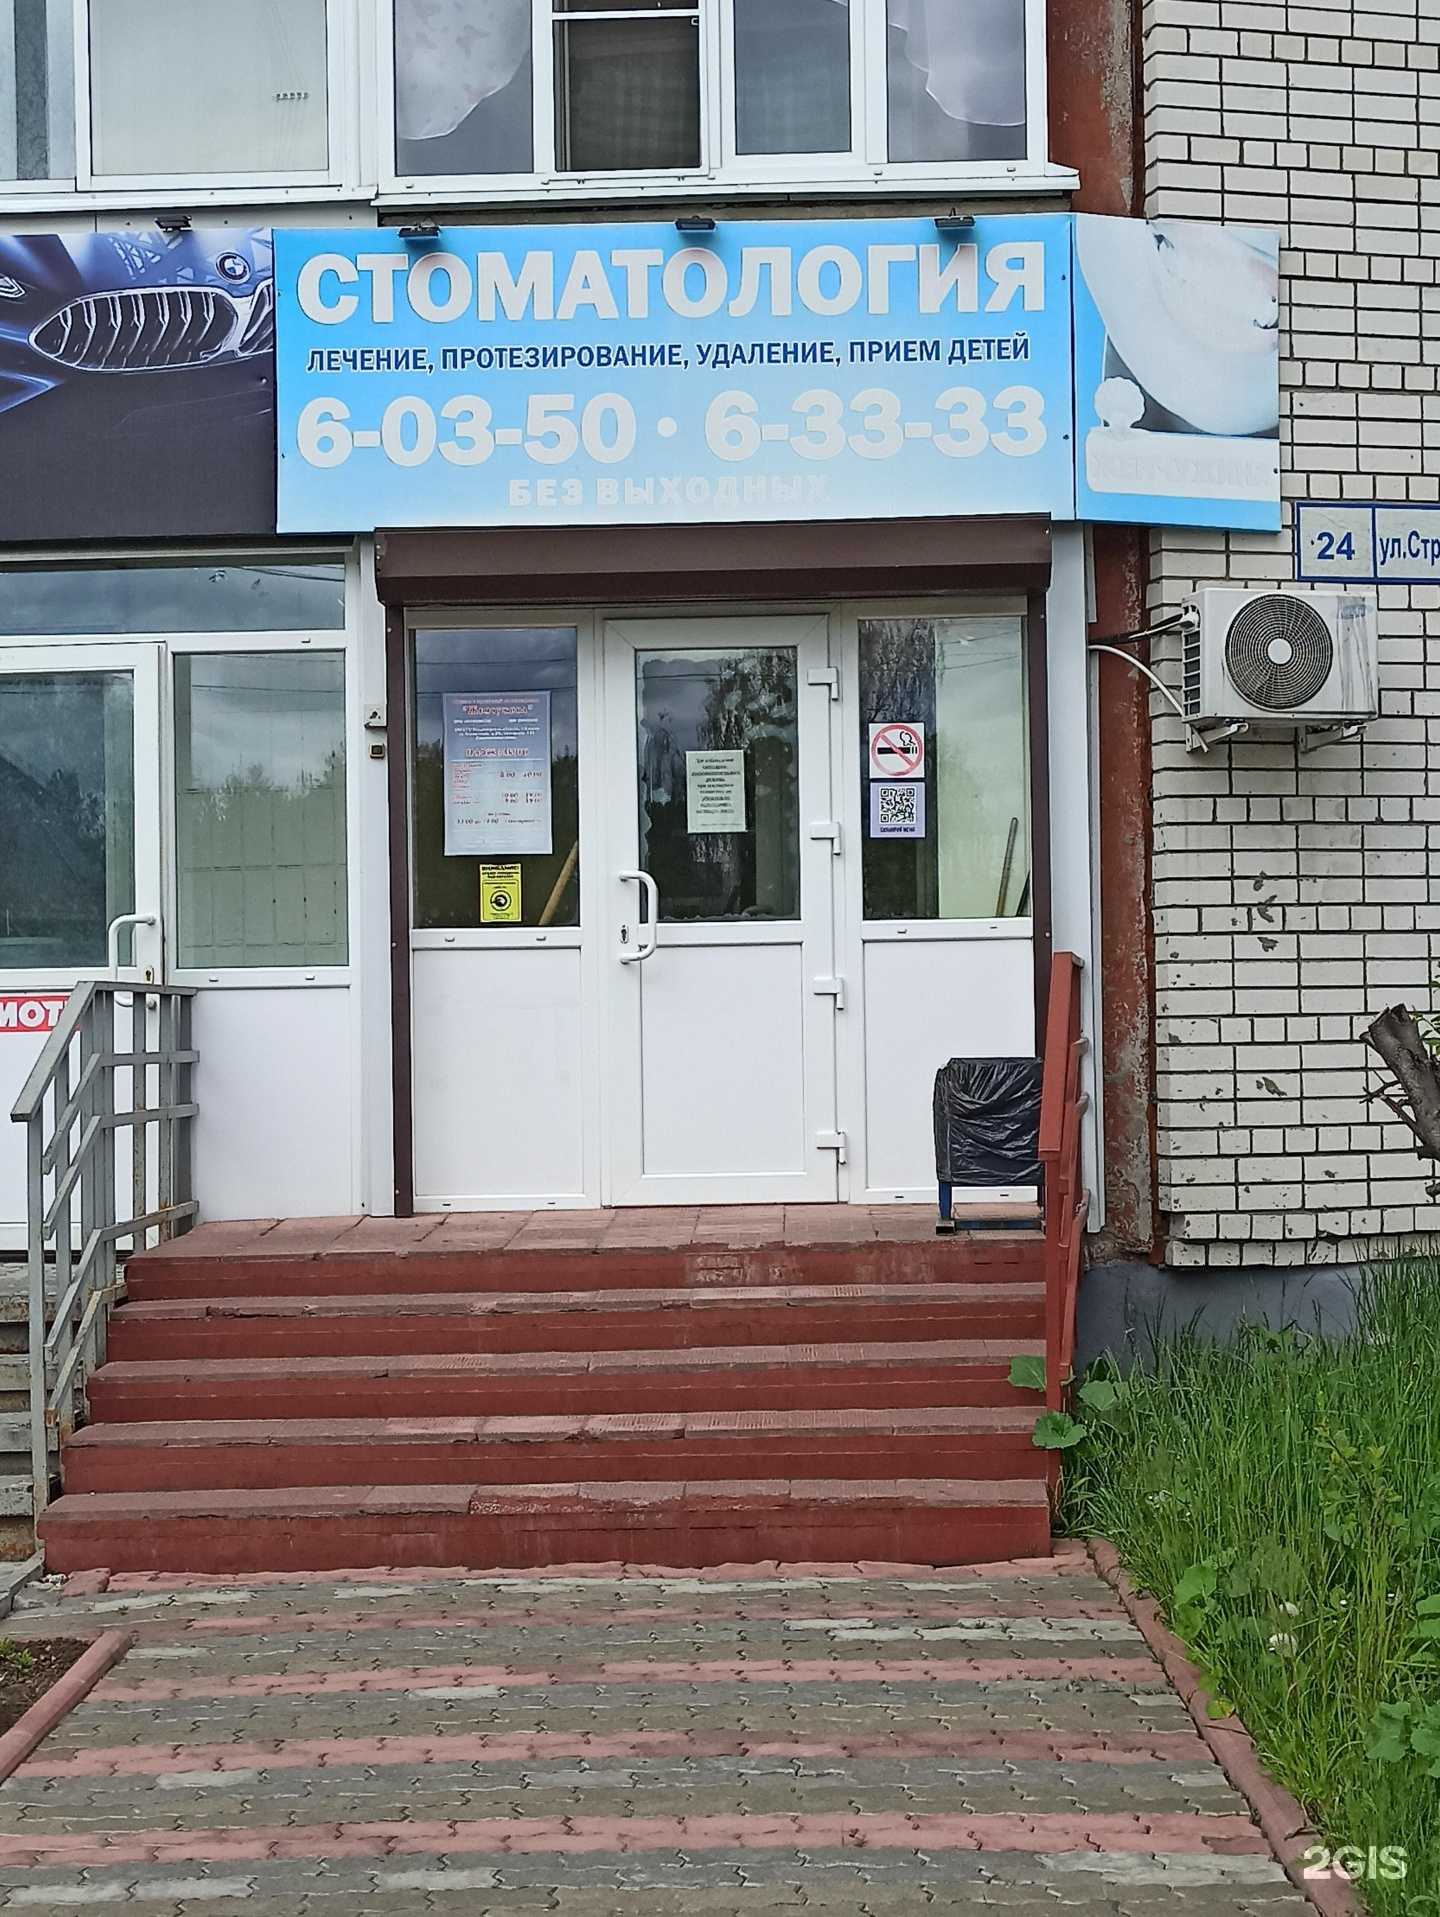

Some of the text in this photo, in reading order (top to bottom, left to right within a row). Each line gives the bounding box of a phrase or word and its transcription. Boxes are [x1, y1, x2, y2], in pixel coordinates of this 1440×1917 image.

[297, 241, 1046, 325] СТОМАТОЛОГИЯ
[307, 330, 1030, 374] ЛЕЧЕНИЕ, ПРОТЕЗИРОВАНИЕ, УДАЛЕНИЕ, ПРИЕМ ДЕТЕЙ
[297, 385, 1048, 470] 6-03-50 6-33-33
[508, 472, 832, 509] БЕЗ ВЫХОДНЫХ
[1316, 531, 1356, 561] 24
